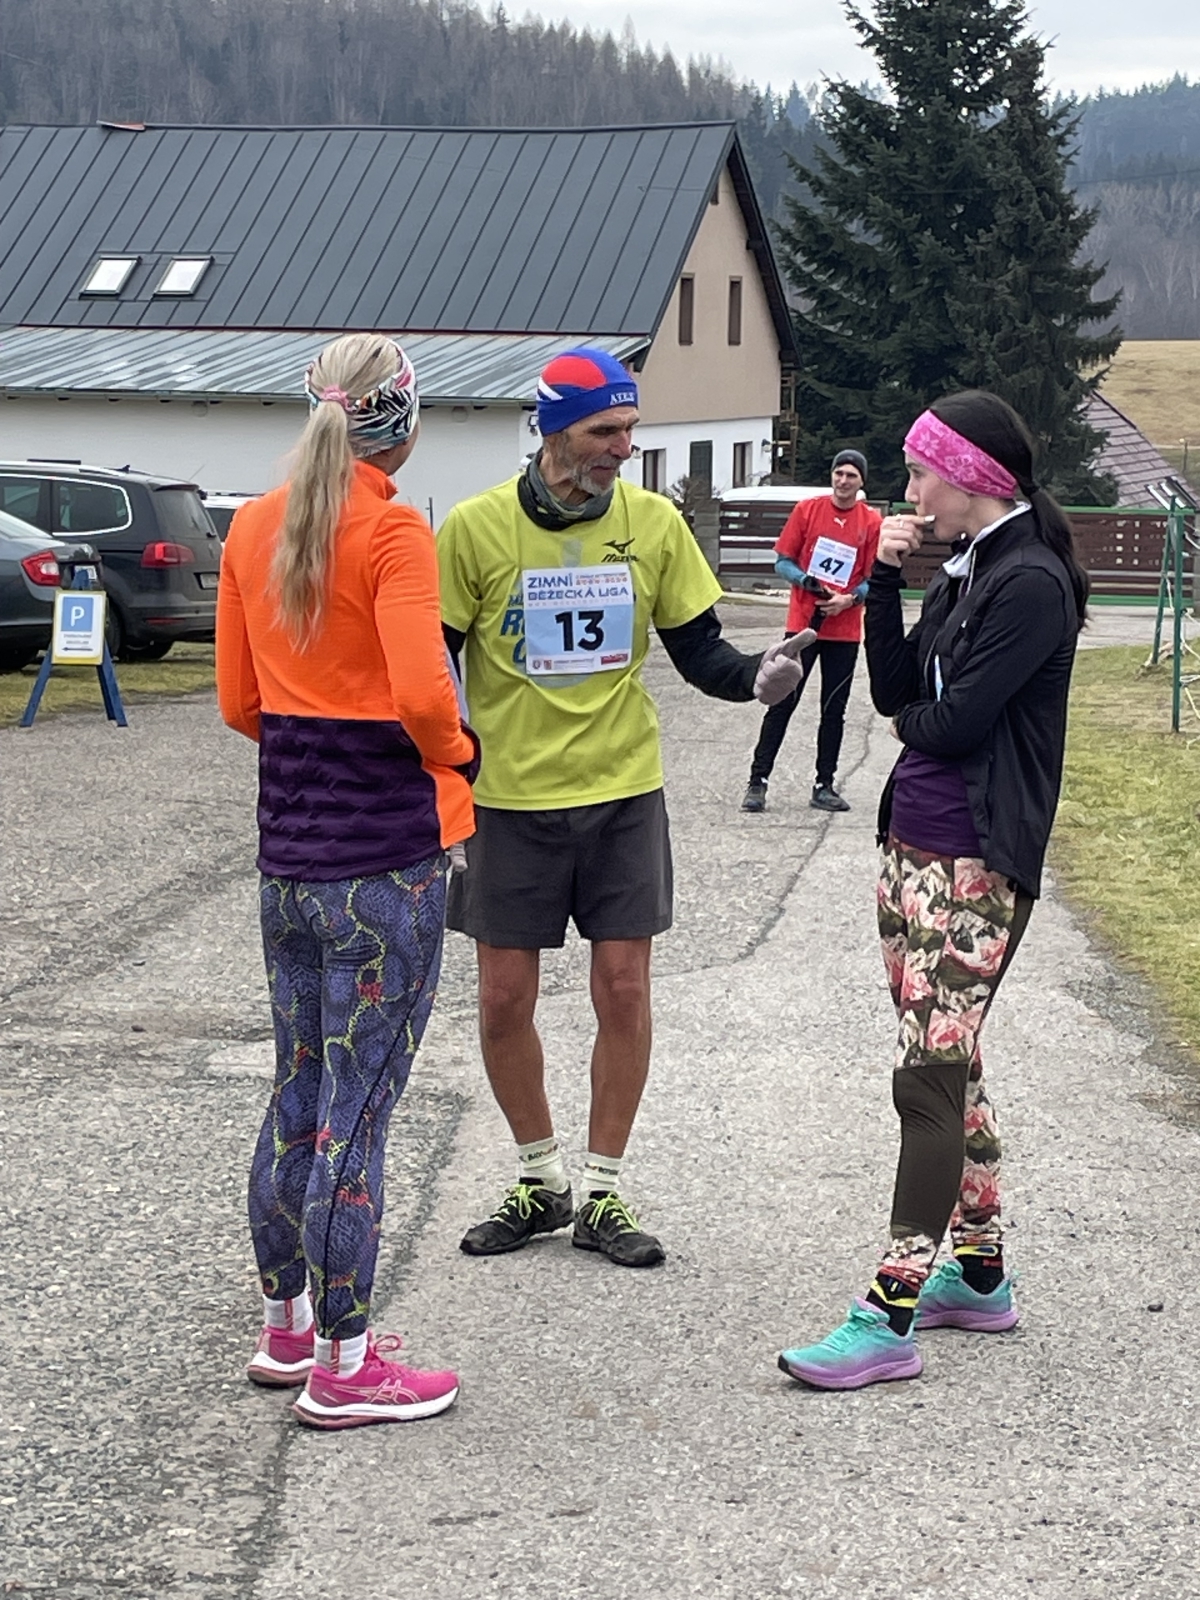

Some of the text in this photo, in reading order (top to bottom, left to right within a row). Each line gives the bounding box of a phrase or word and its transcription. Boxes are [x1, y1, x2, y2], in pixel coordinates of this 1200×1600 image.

[819, 557, 845, 575] 47
[527, 573, 573, 589] ZIMNÍ
[598, 586, 629, 598] LIGA
[70, 605, 85, 627] P
[555, 610, 605, 652] 13
